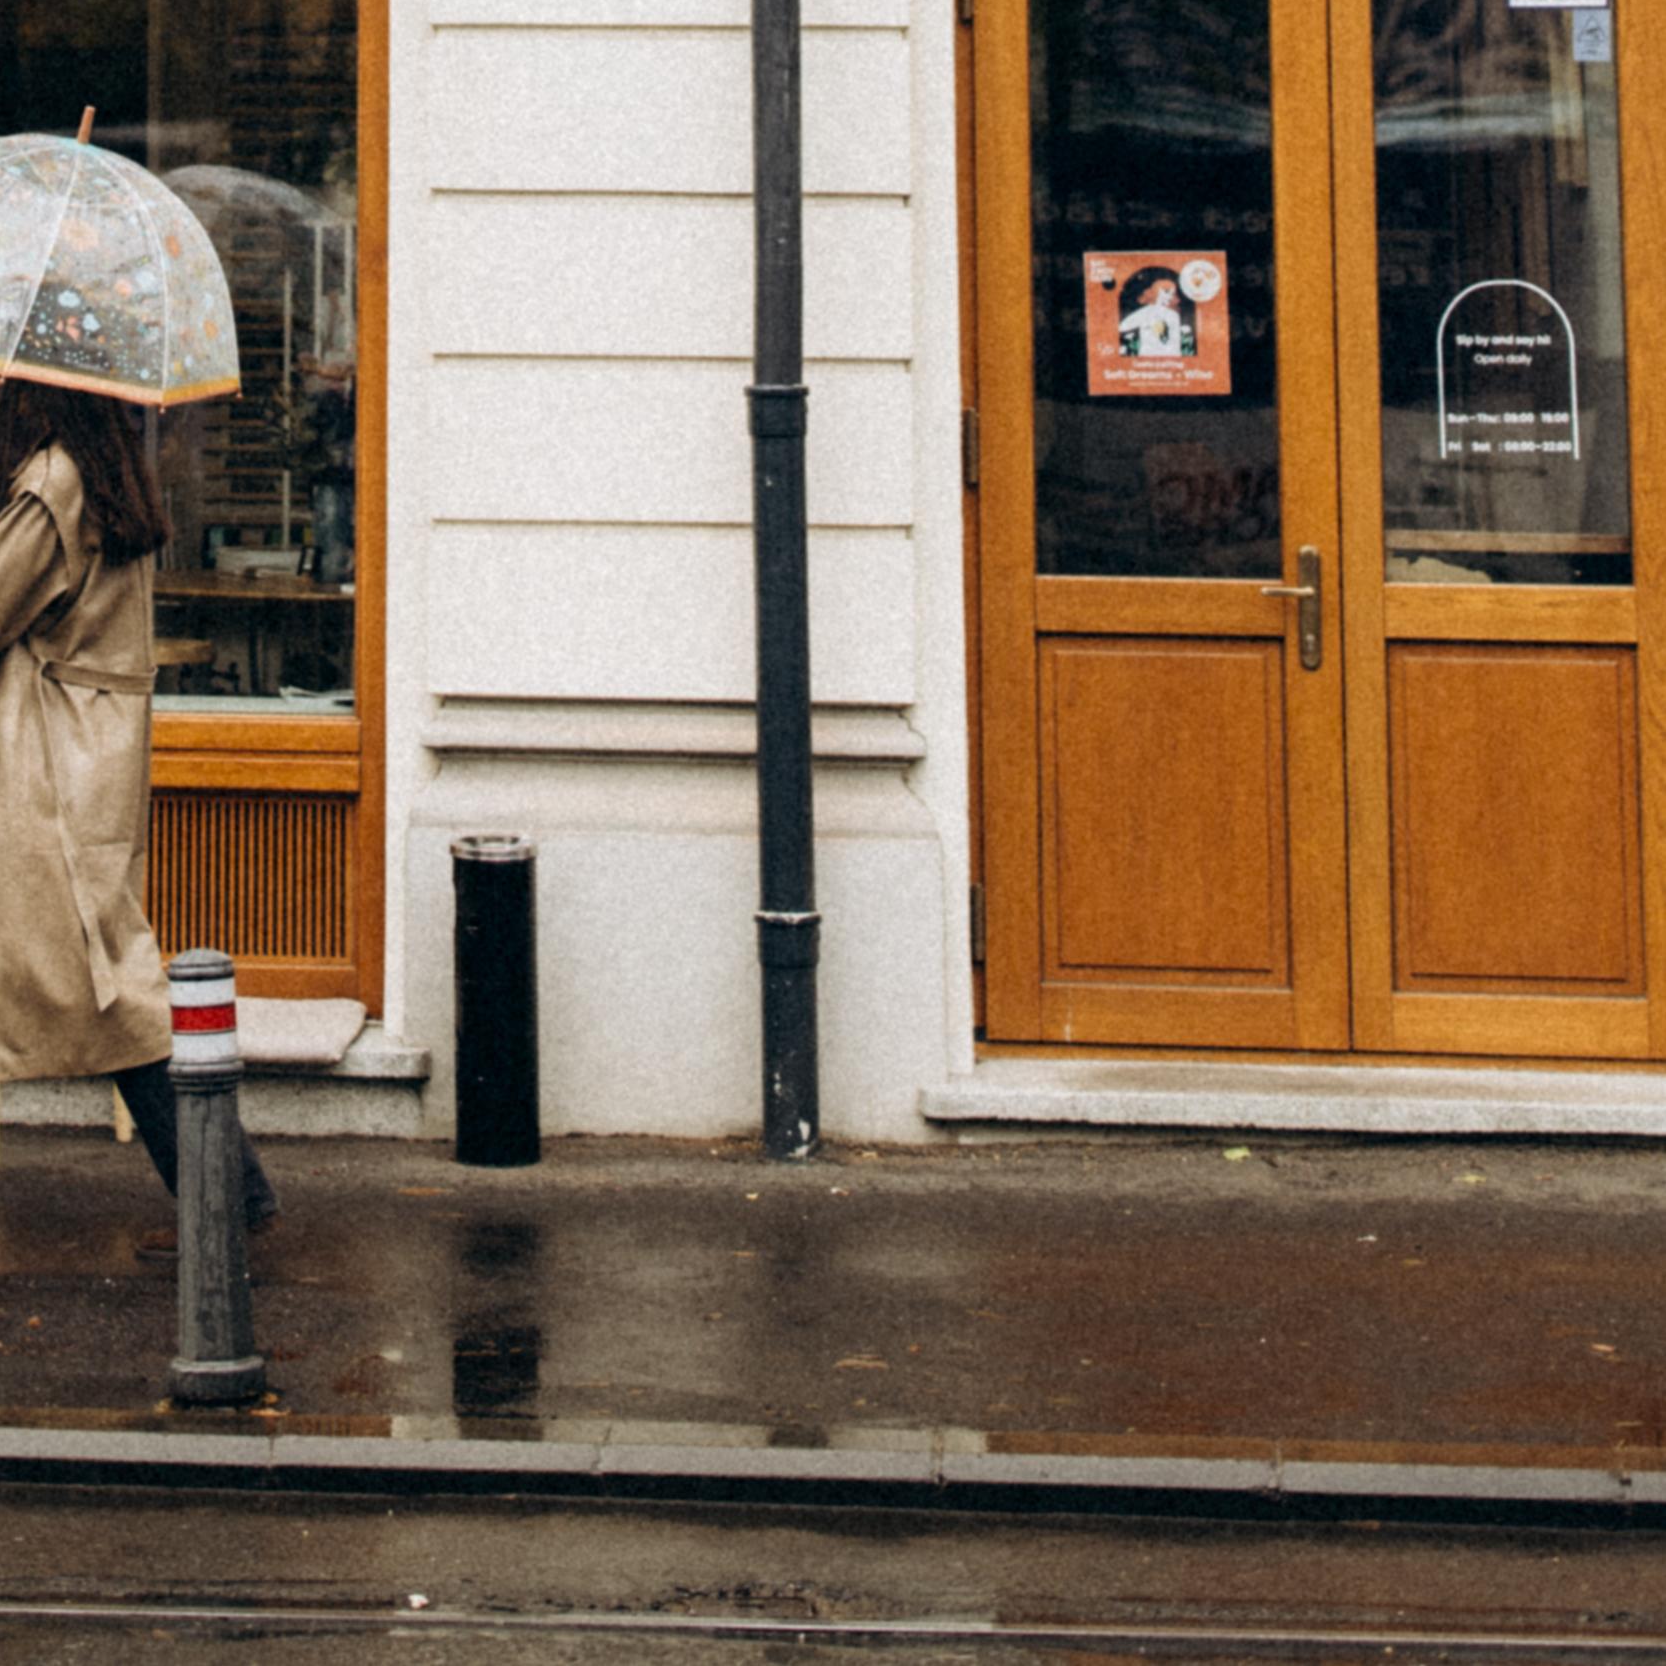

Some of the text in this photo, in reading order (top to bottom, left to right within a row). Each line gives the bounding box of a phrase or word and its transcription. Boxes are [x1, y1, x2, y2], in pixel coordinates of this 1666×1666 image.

[1491, 334, 1514, 345] and
[1474, 353, 1532, 366] Open daily
